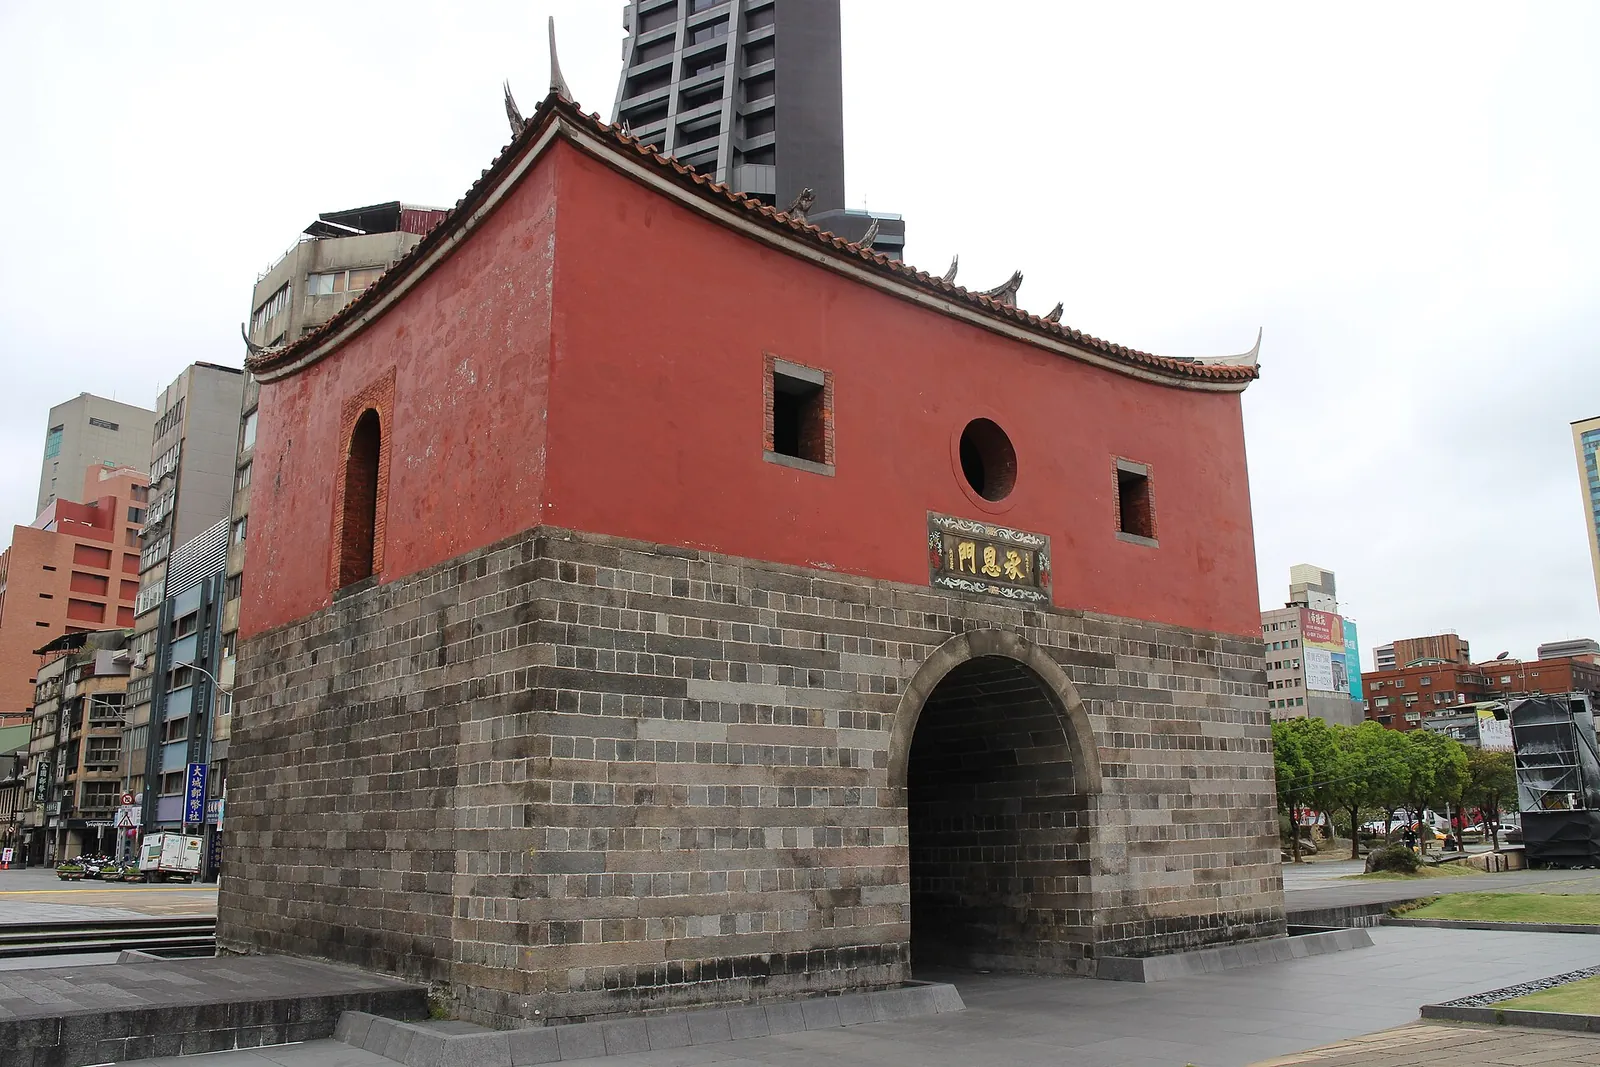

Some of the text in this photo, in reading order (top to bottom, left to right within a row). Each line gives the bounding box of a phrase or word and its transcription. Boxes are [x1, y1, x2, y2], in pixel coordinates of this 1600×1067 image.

[189, 765, 204, 821] 大城郵幣社
